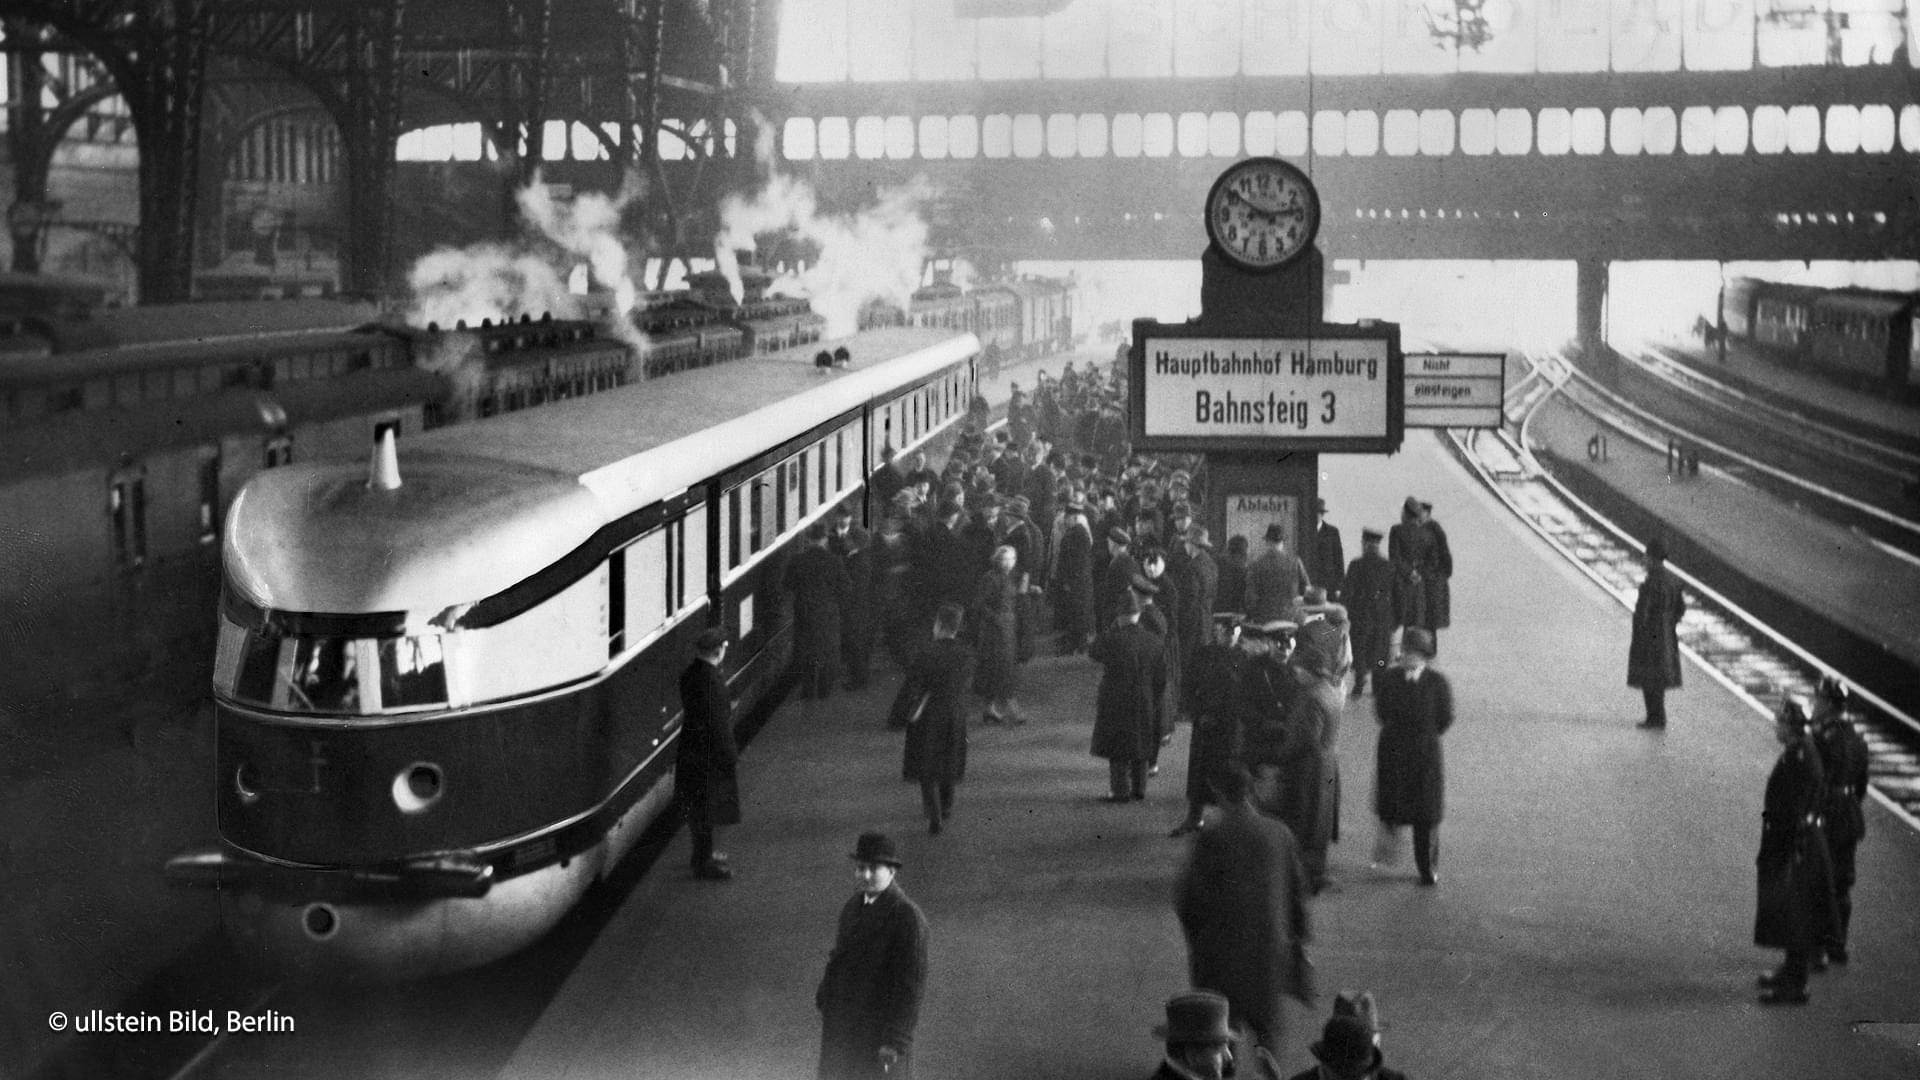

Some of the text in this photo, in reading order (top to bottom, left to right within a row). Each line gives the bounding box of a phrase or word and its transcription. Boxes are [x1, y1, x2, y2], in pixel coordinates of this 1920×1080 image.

[1239, 178, 1252, 193] 11
[1256, 174, 1270, 190] 12
[1277, 178, 1284, 192] 1
[1288, 189, 1298, 206] 2
[1221, 206, 1230, 223] 9
[1228, 224, 1237, 241] 8
[1287, 225, 1297, 240] 4
[1242, 238, 1249, 253] 7
[1259, 239, 1267, 256] 6
[1276, 237, 1284, 253] 5
[1155, 350, 1378, 380] Hauptbahnhof Hamburg
[1423, 358, 1450, 370] Nicht
[1414, 383, 1471, 400] einsteigen
[1196, 389, 1337, 430] Bahnsteig 3
[1237, 496, 1289, 512] Abfahrt
